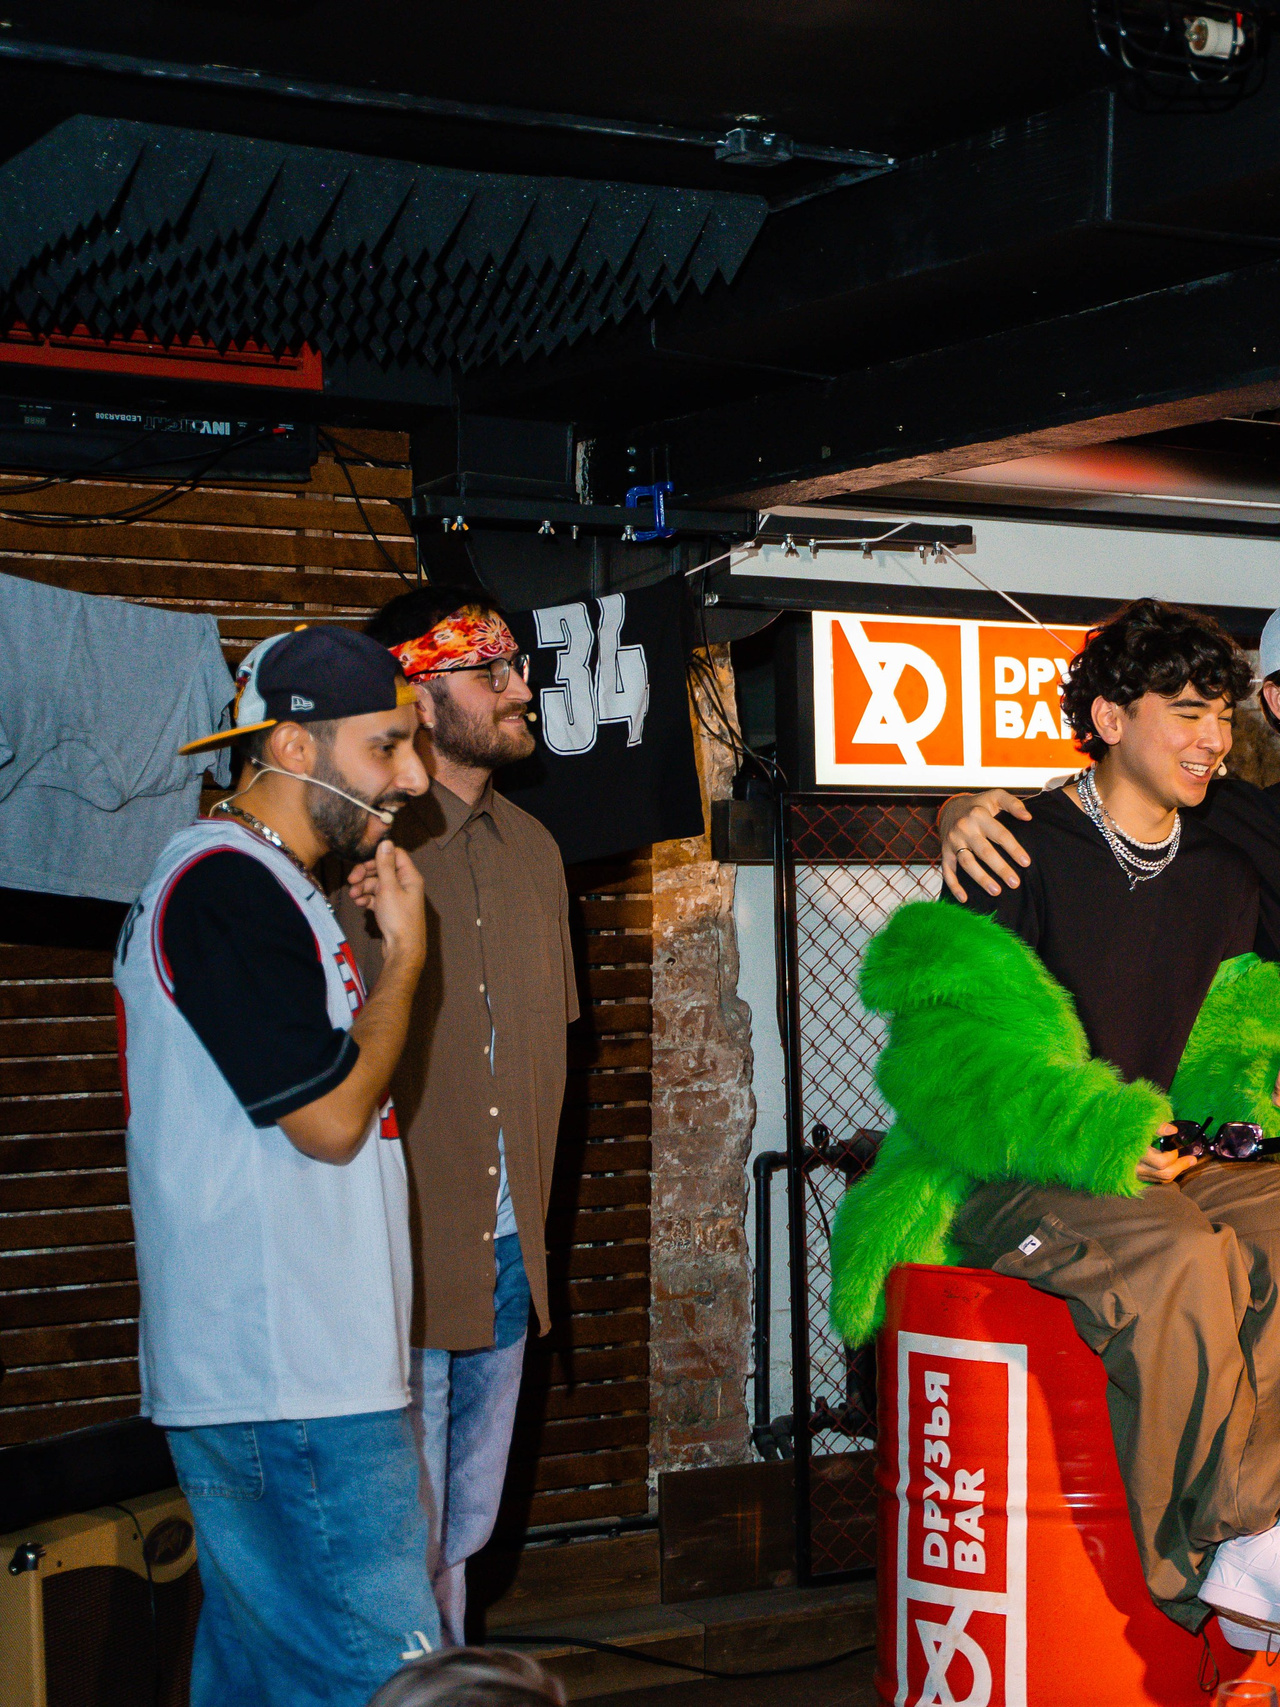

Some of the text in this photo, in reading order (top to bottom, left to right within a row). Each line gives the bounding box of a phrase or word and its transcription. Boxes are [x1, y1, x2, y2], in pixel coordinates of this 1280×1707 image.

[95, 412, 142, 423] LEDBAR308
[532, 592, 650, 756] 34
[952, 1467, 986, 1575] BAR
